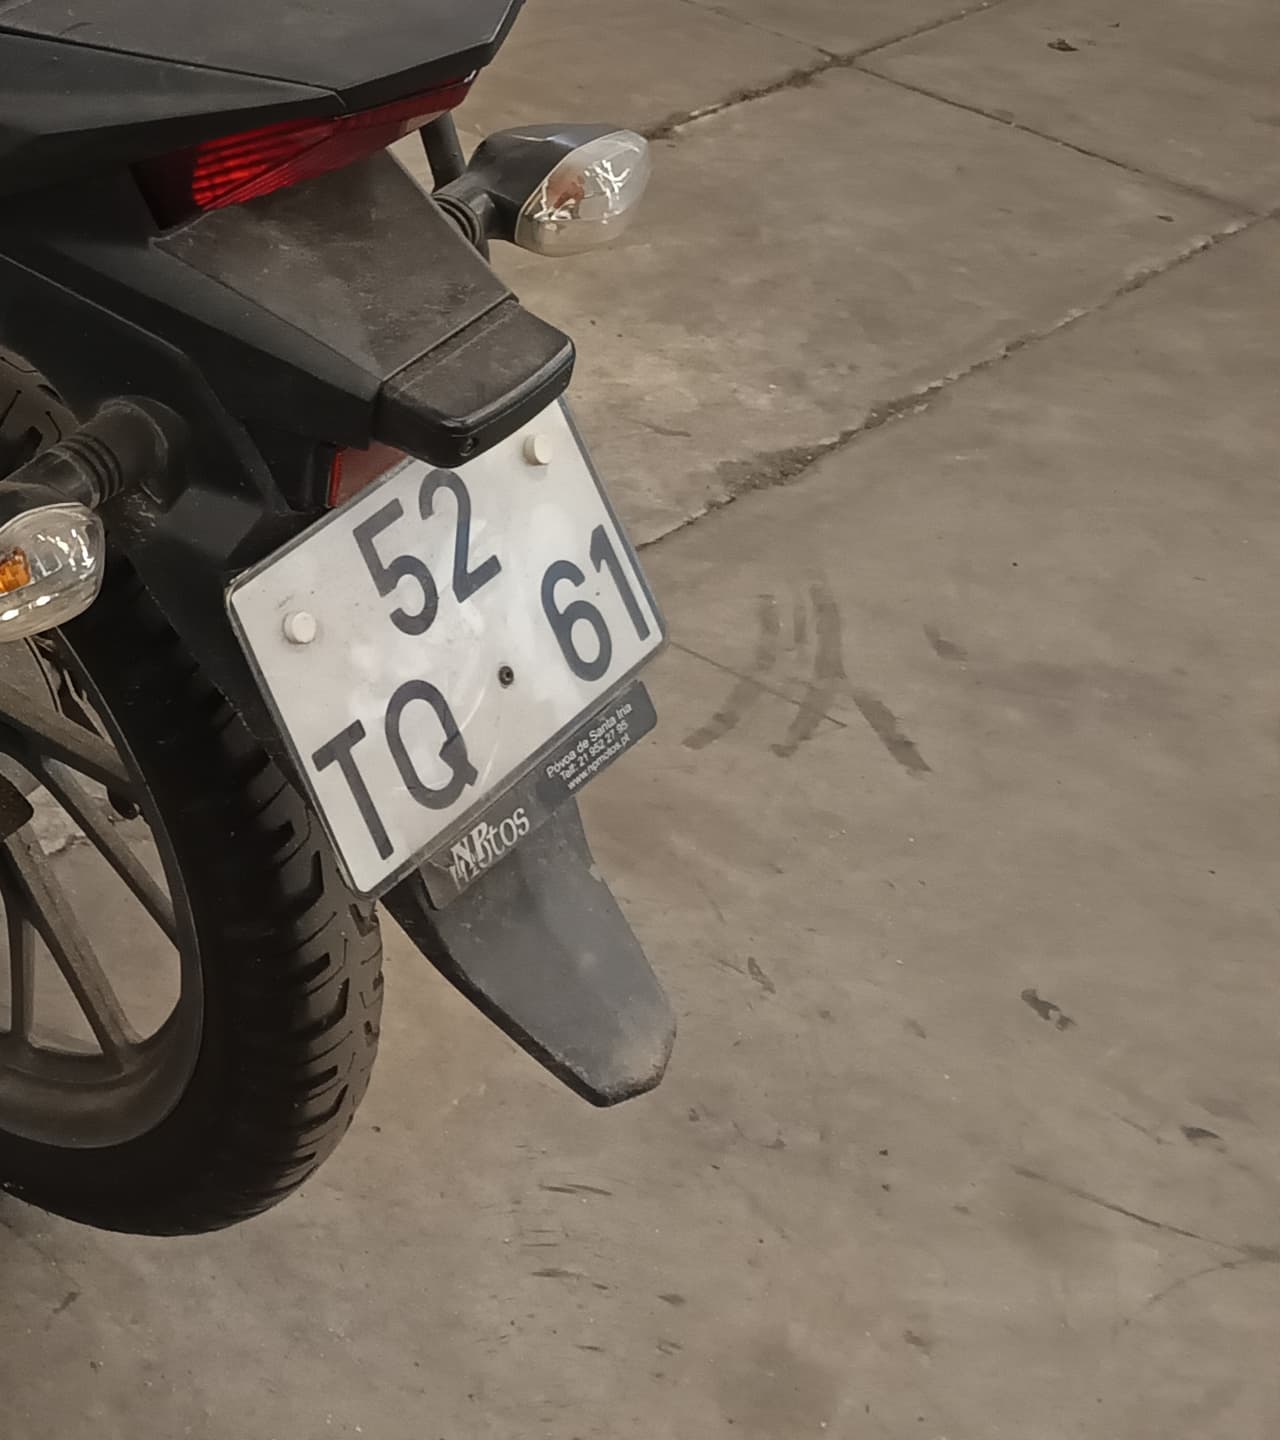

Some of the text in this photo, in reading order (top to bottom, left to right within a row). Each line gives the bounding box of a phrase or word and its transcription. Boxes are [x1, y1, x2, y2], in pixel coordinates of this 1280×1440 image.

[352, 469, 502, 636] 52
[312, 524, 651, 861] TQ 61
[546, 703, 632, 778] Póvoa de Santa Iria
[568, 733, 630, 790] www.npmotos.pt
[577, 753, 589, 767] 21
[589, 738, 605, 757] 952
[605, 729, 615, 744] 27
[616, 720, 629, 734] 95
